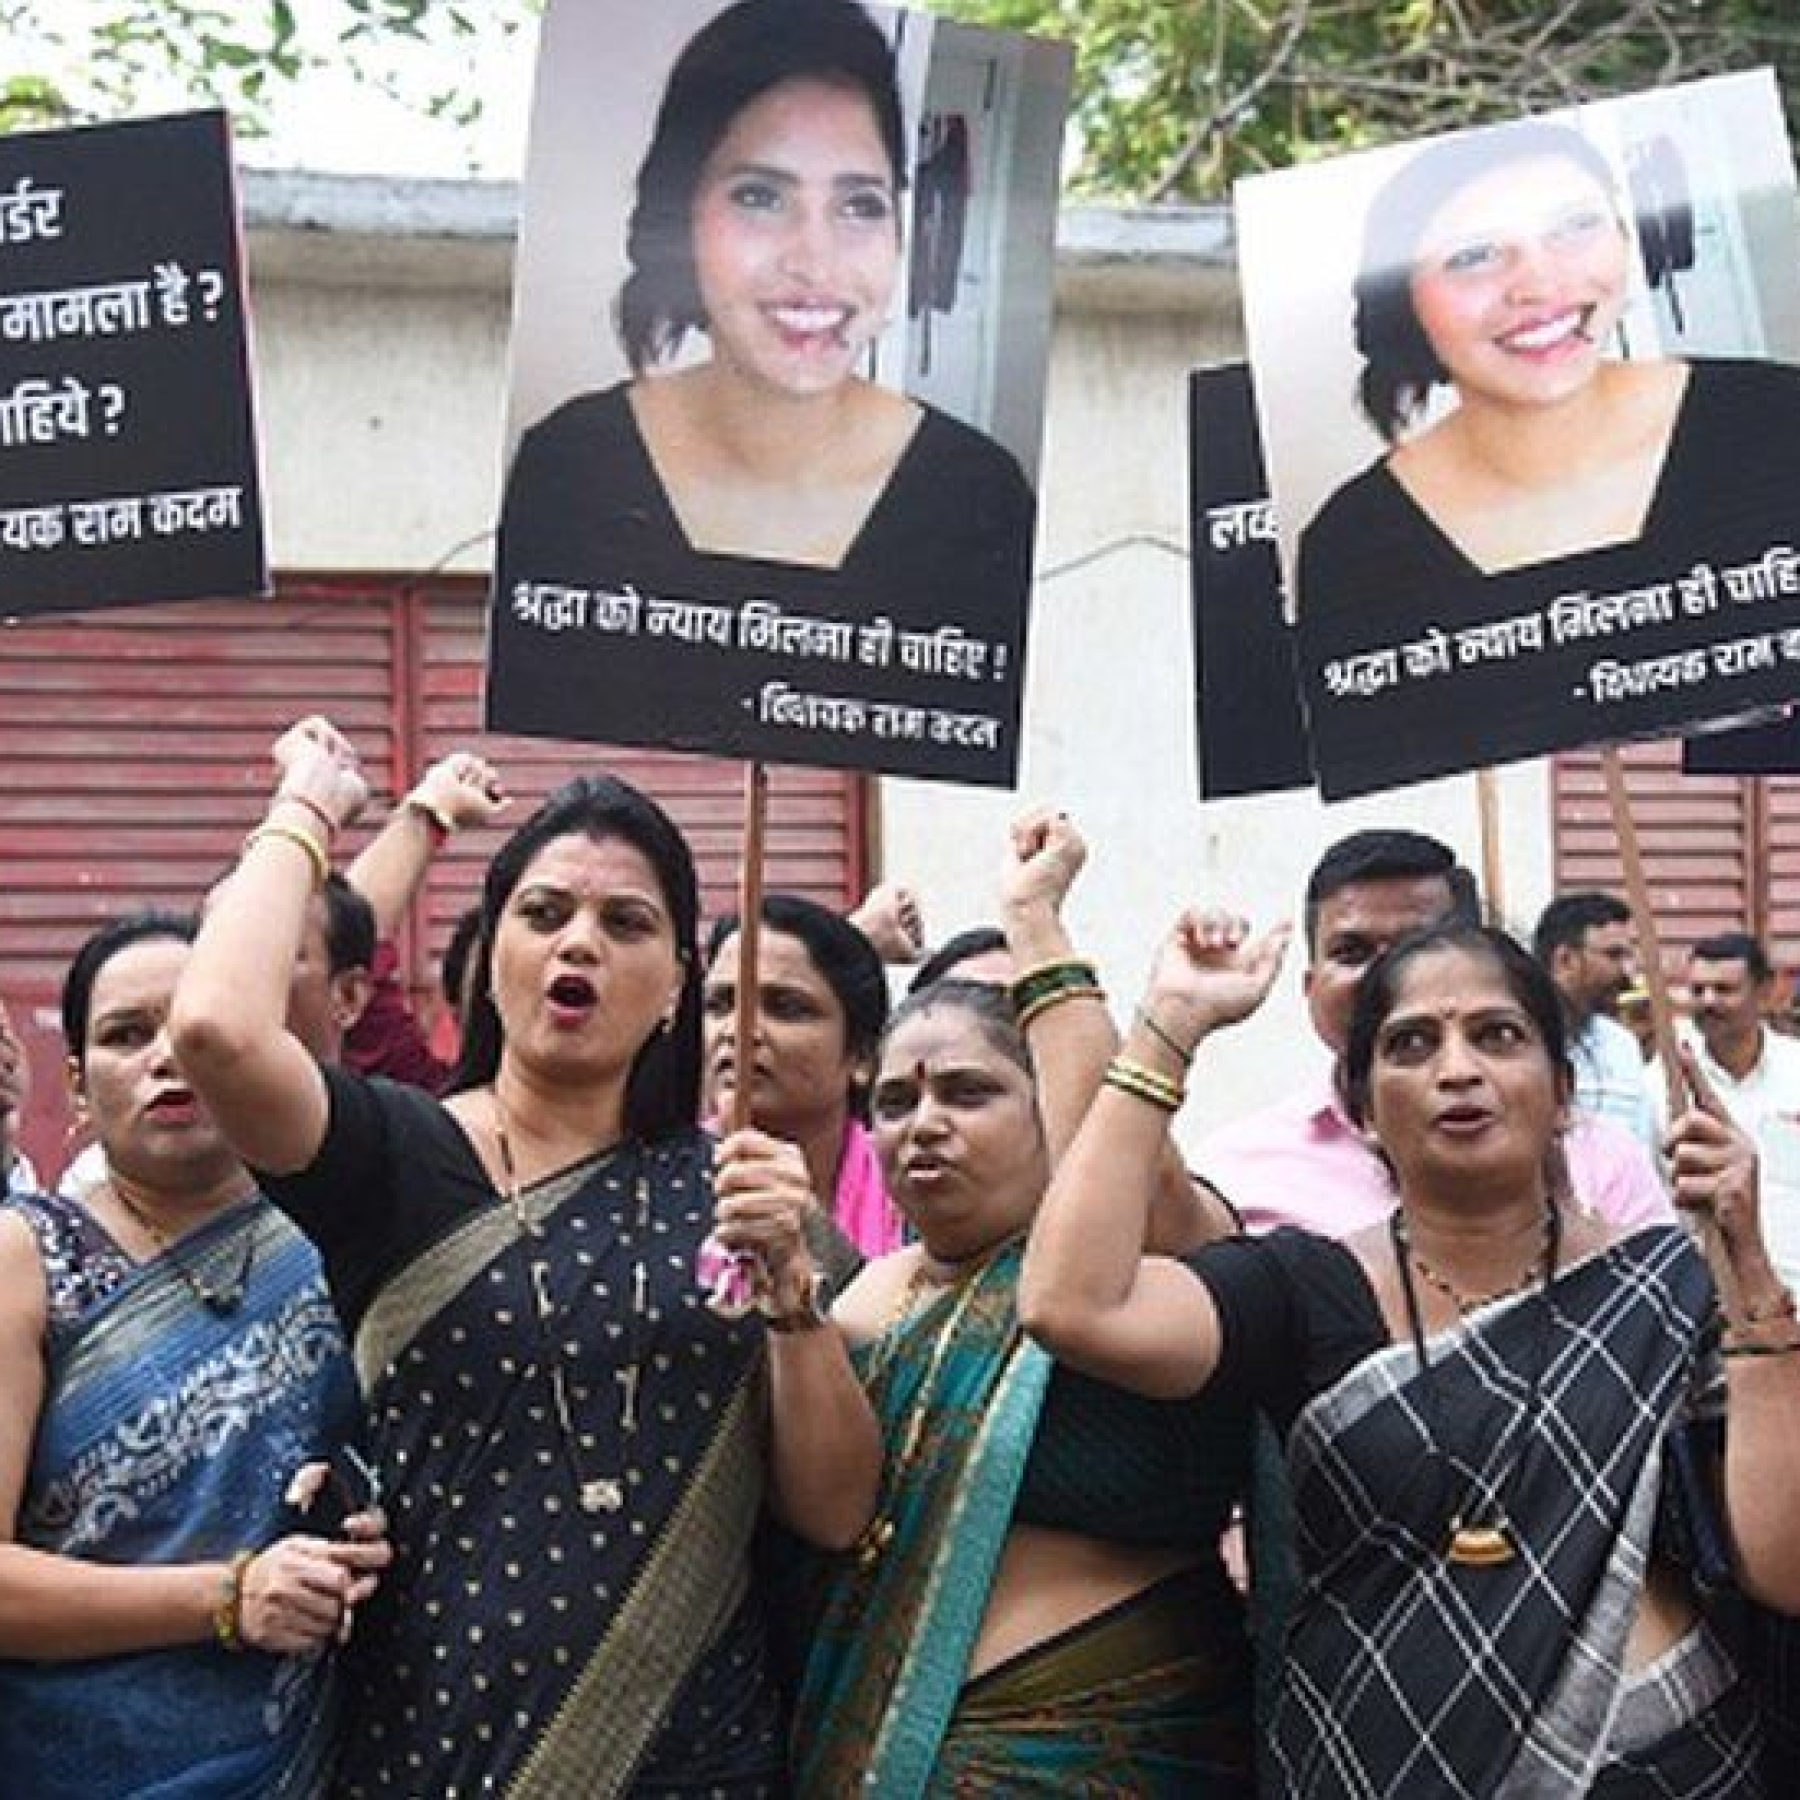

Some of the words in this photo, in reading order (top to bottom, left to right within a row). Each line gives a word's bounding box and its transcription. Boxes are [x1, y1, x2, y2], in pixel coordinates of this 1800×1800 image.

[0, 176, 63, 243] र्डर
[0, 282, 151, 341] मामला
[153, 262, 191, 325] है
[197, 271, 224, 321] ?
[0, 376, 91, 446] ाहिये
[98, 384, 125, 436] ?
[0, 505, 64, 549] यक
[69, 497, 142, 545] राम
[147, 487, 243, 532] कदम
[511, 581, 590, 630] श्रद्धा
[593, 583, 643, 636] को
[646, 599, 734, 645] न्याय
[738, 600, 854, 663] मिलना
[858, 616, 893, 669] ही
[1324, 649, 1397, 696] श्रद्धा
[1401, 628, 1450, 676] को
[1453, 612, 1542, 663] न्याय
[1547, 589, 1673, 644] मिलना
[1675, 563, 1718, 614] ही
[1720, 547, 1800, 603] चाहि
[1711, 633, 1775, 676] राम
